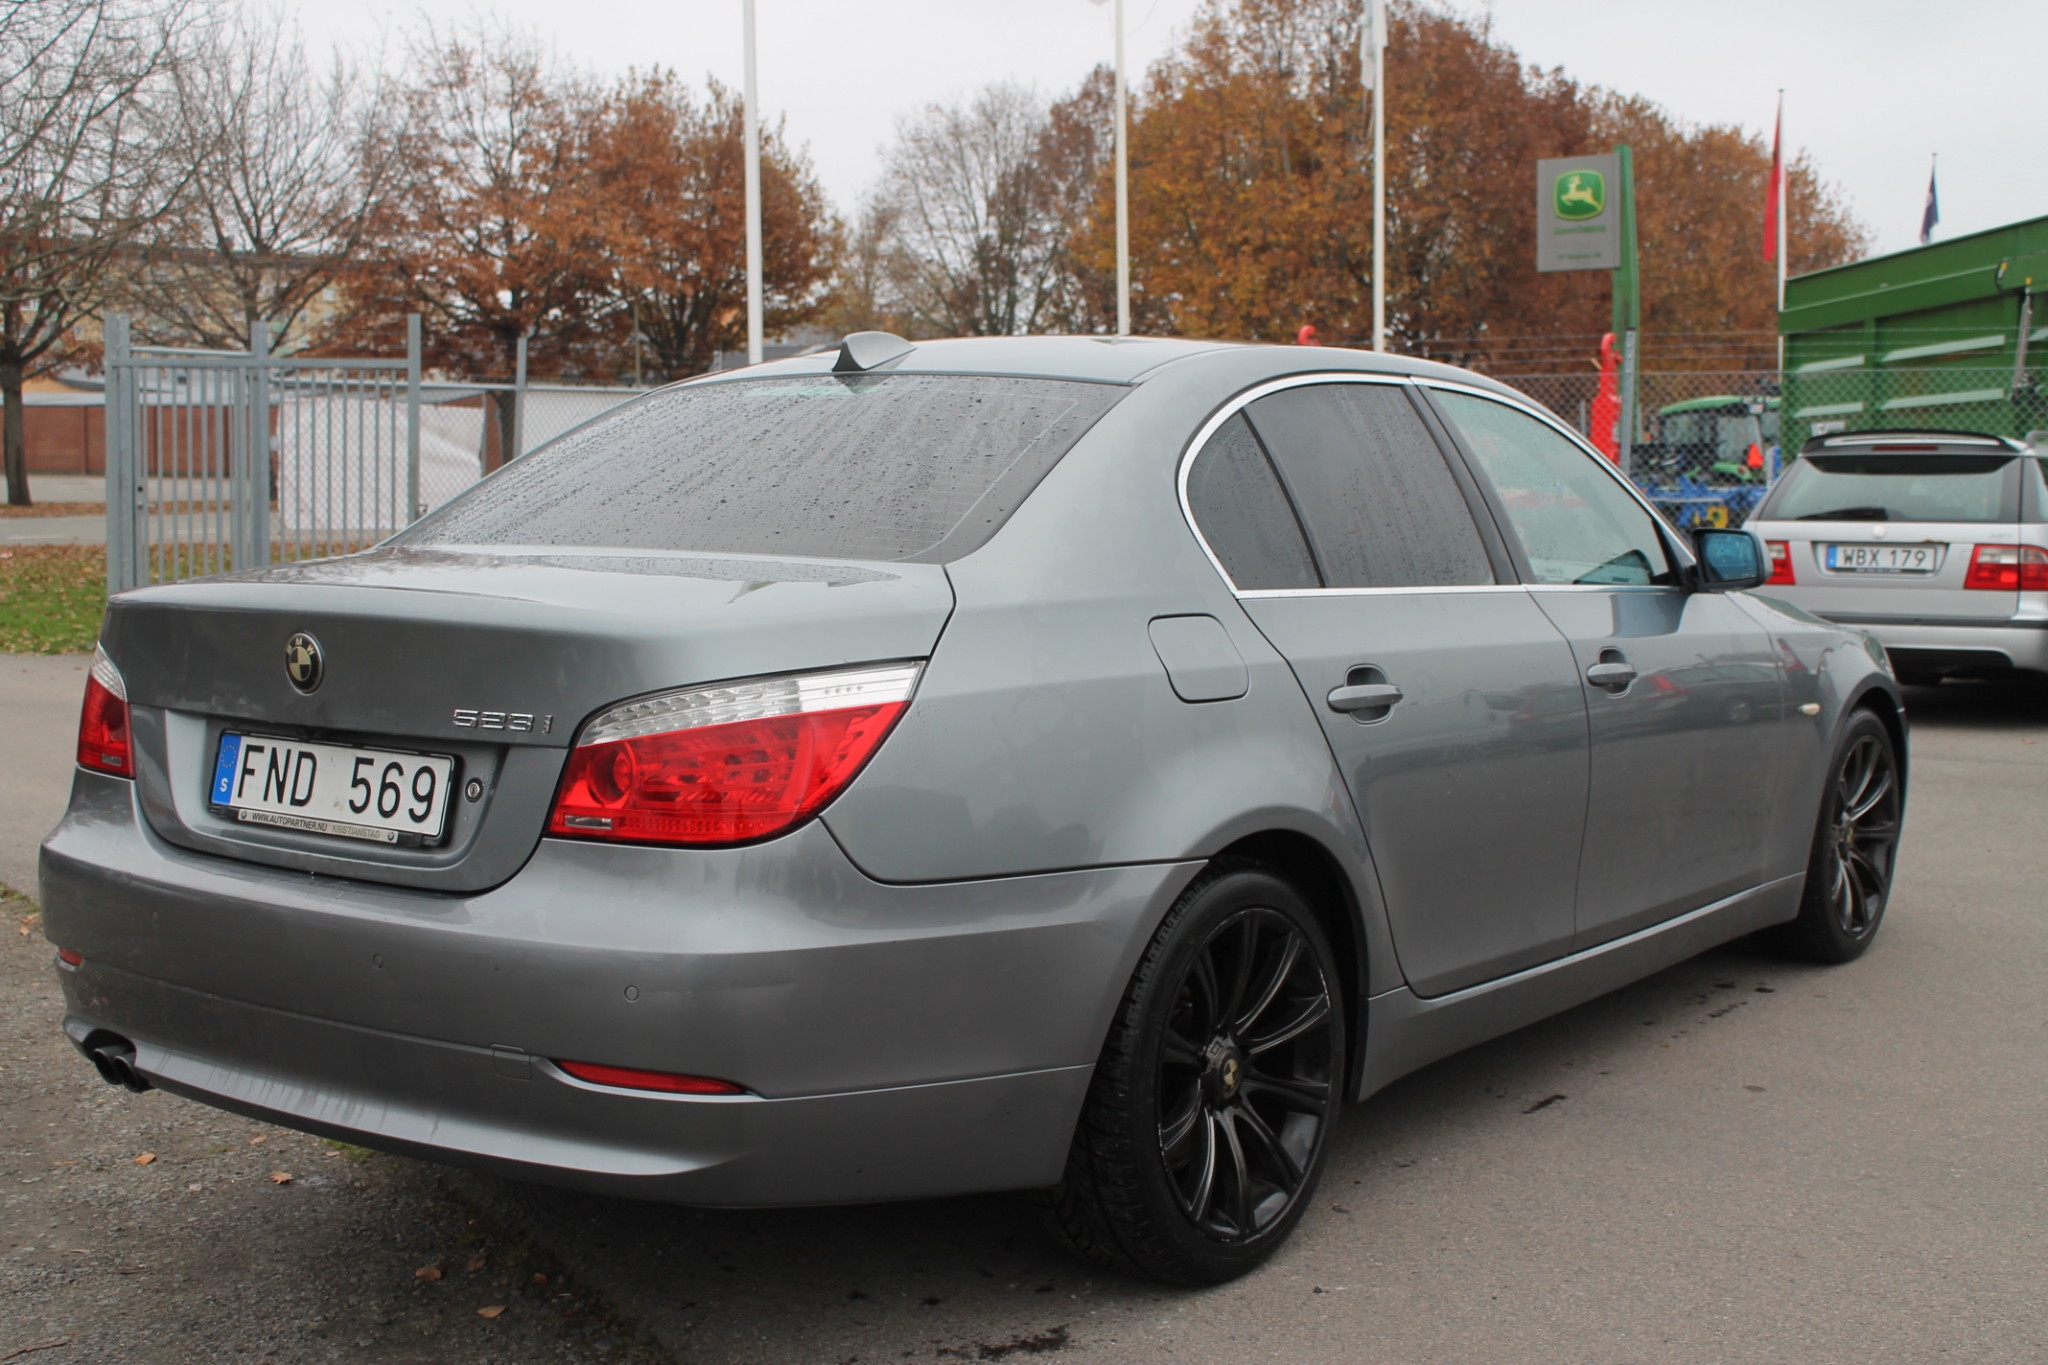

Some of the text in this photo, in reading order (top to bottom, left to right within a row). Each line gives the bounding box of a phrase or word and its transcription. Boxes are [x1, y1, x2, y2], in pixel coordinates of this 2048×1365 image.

[1843, 549, 1926, 567] WBX 179
[286, 637, 316, 656] BMW
[220, 778, 229, 793] S
[238, 745, 436, 823] FND 569
[252, 812, 381, 839] WWW.AUTOPARTNER.NU KRISTIANSTAD
